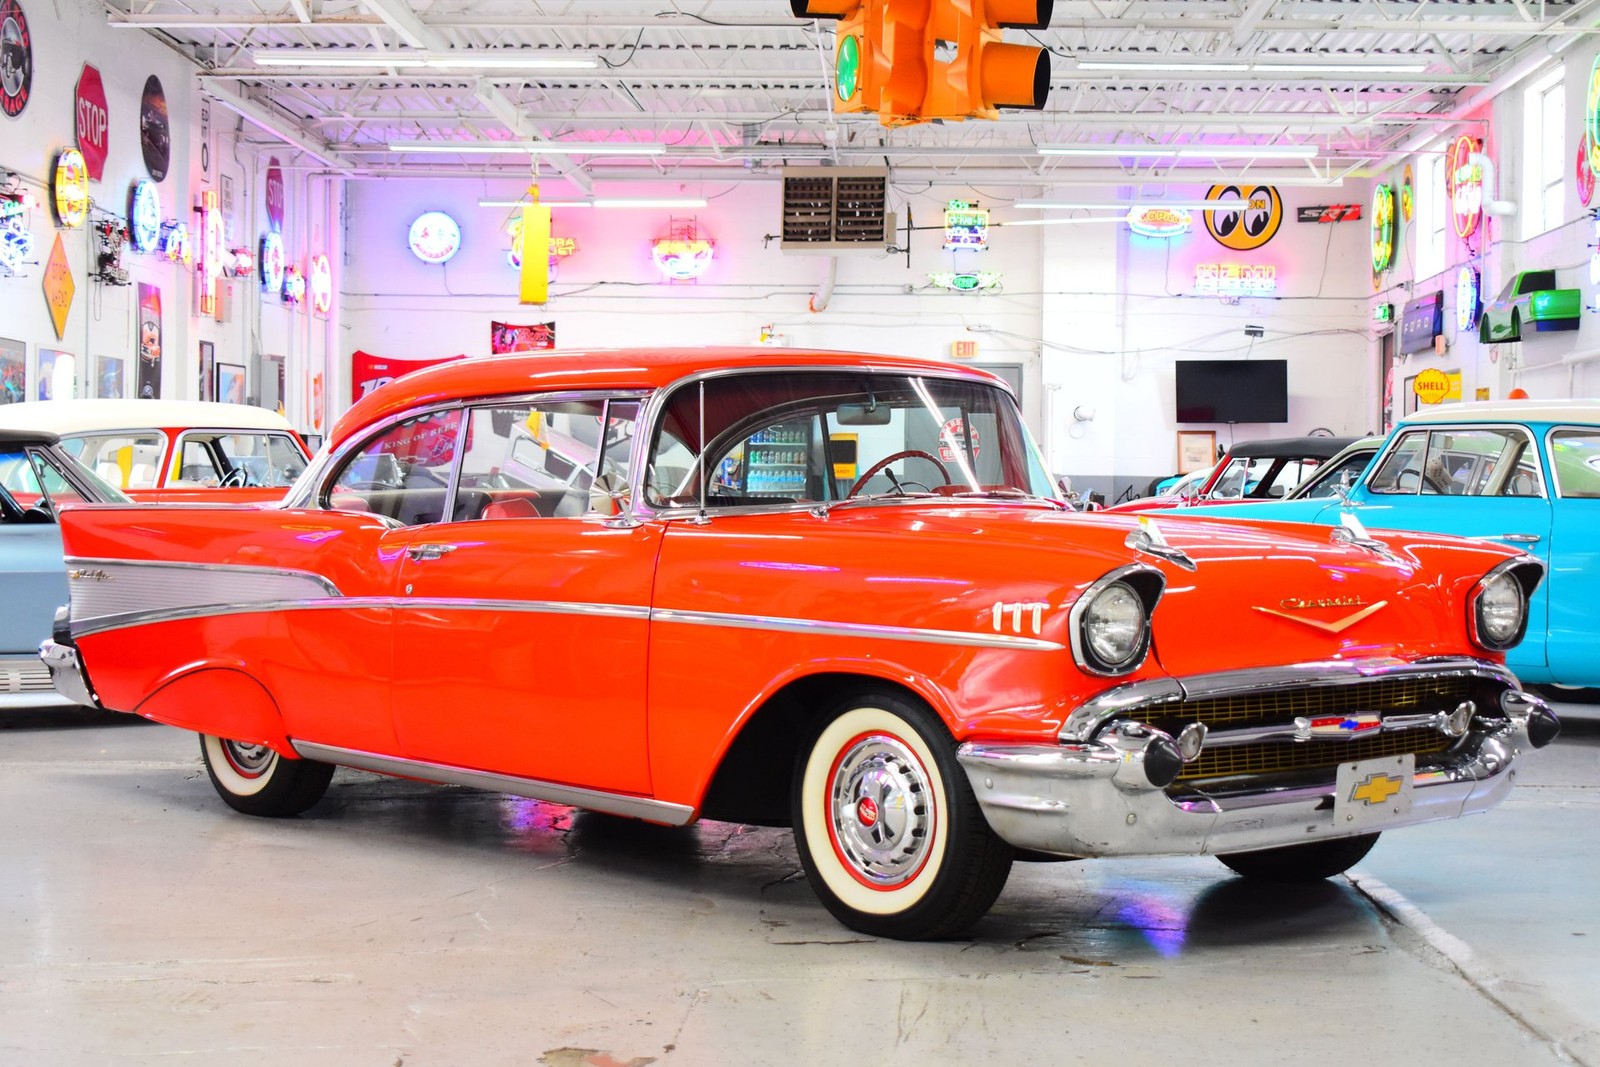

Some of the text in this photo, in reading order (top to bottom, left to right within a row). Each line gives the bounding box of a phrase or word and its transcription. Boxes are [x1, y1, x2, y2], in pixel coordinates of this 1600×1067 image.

[79, 97, 107, 148] STOP
[1248, 200, 1266, 210] ON
[1299, 208, 1360, 220] SRT
[548, 237, 576, 247] BRA
[1403, 316, 1430, 335] FORD
[956, 341, 976, 356] EXIT
[1417, 381, 1446, 391] SHELL
[384, 421, 459, 450] KING OF BEER
